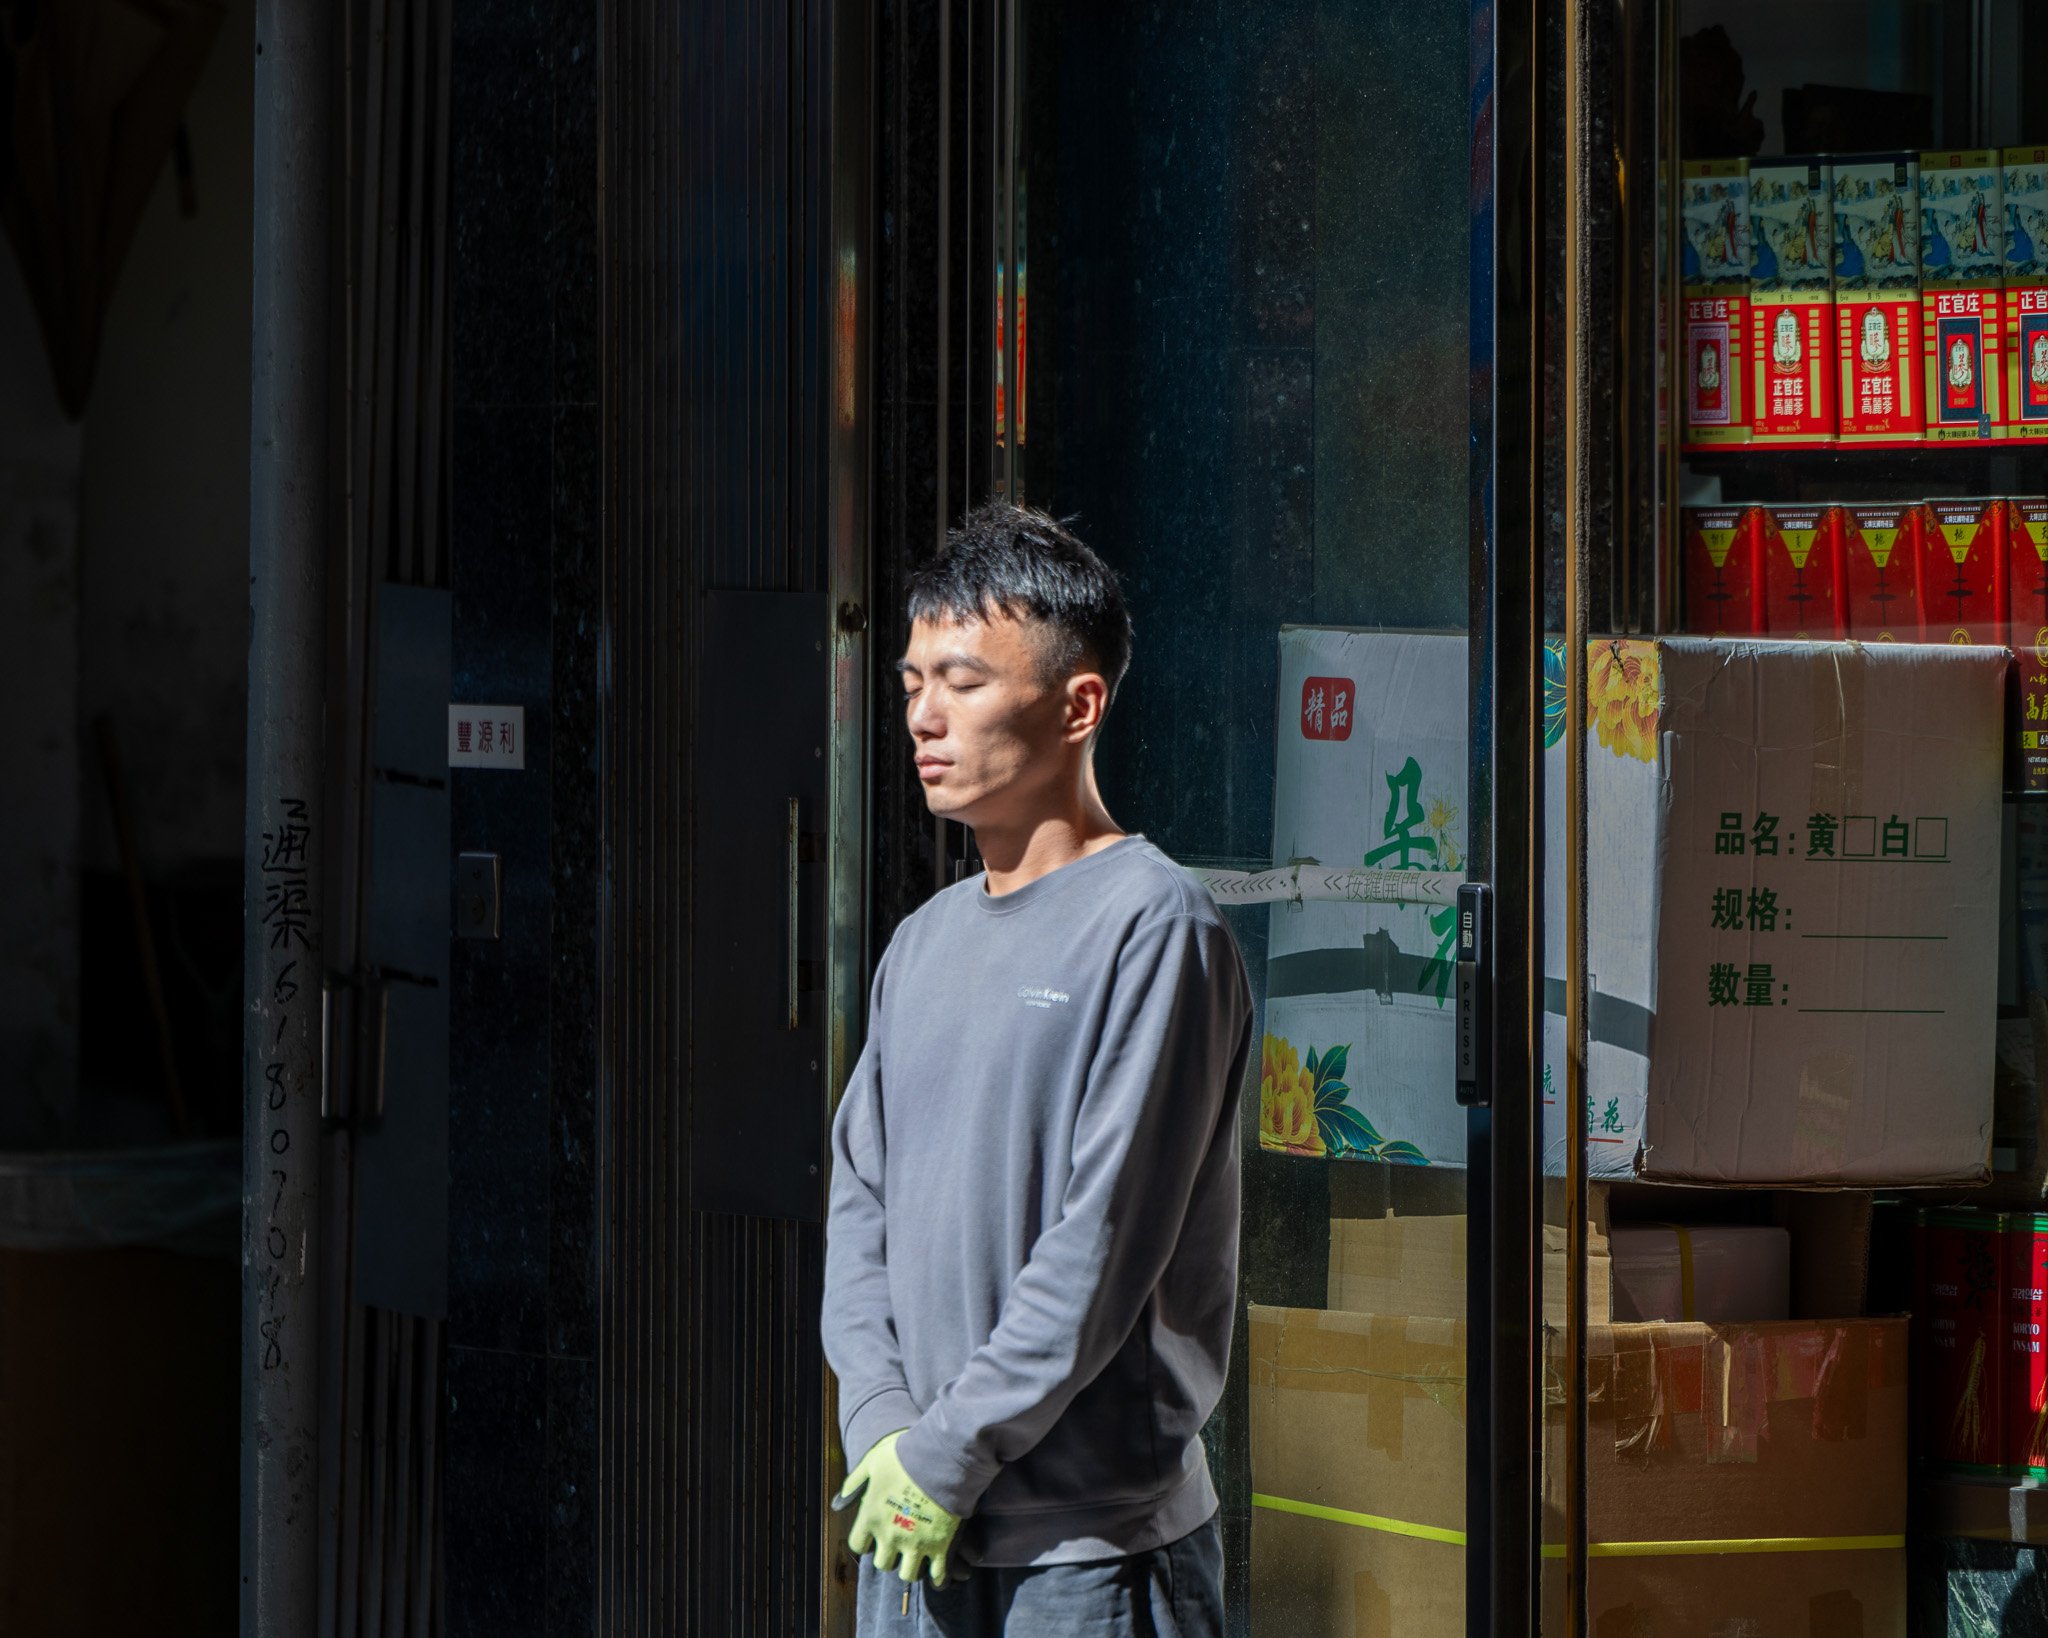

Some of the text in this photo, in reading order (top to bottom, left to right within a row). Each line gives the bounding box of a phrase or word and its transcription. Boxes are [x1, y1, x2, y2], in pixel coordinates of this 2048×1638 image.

[1689, 299, 1729, 319] 正官庄
[1938, 293, 1979, 313] 正官庄
[1773, 379, 1804, 397] 正官庄
[1861, 377, 1892, 395] 正官庄
[1796, 556, 1803, 565] 15
[1955, 550, 1963, 560] 20
[1304, 687, 1348, 735] 精品
[457, 720, 515, 754] 豐源利
[1346, 870, 1421, 901] 按鍵開門
[1711, 888, 1792, 932] 规格:
[1462, 911, 1473, 949] 自動
[1708, 963, 1789, 1007] 数量:
[1463, 981, 1471, 1066] PRESS
[2012, 1288, 2044, 1301] 고려인삼
[2012, 1322, 2040, 1336] KORYO
[2012, 1339, 2040, 1353] INSAM
[893, 1513, 916, 1532] 3M
